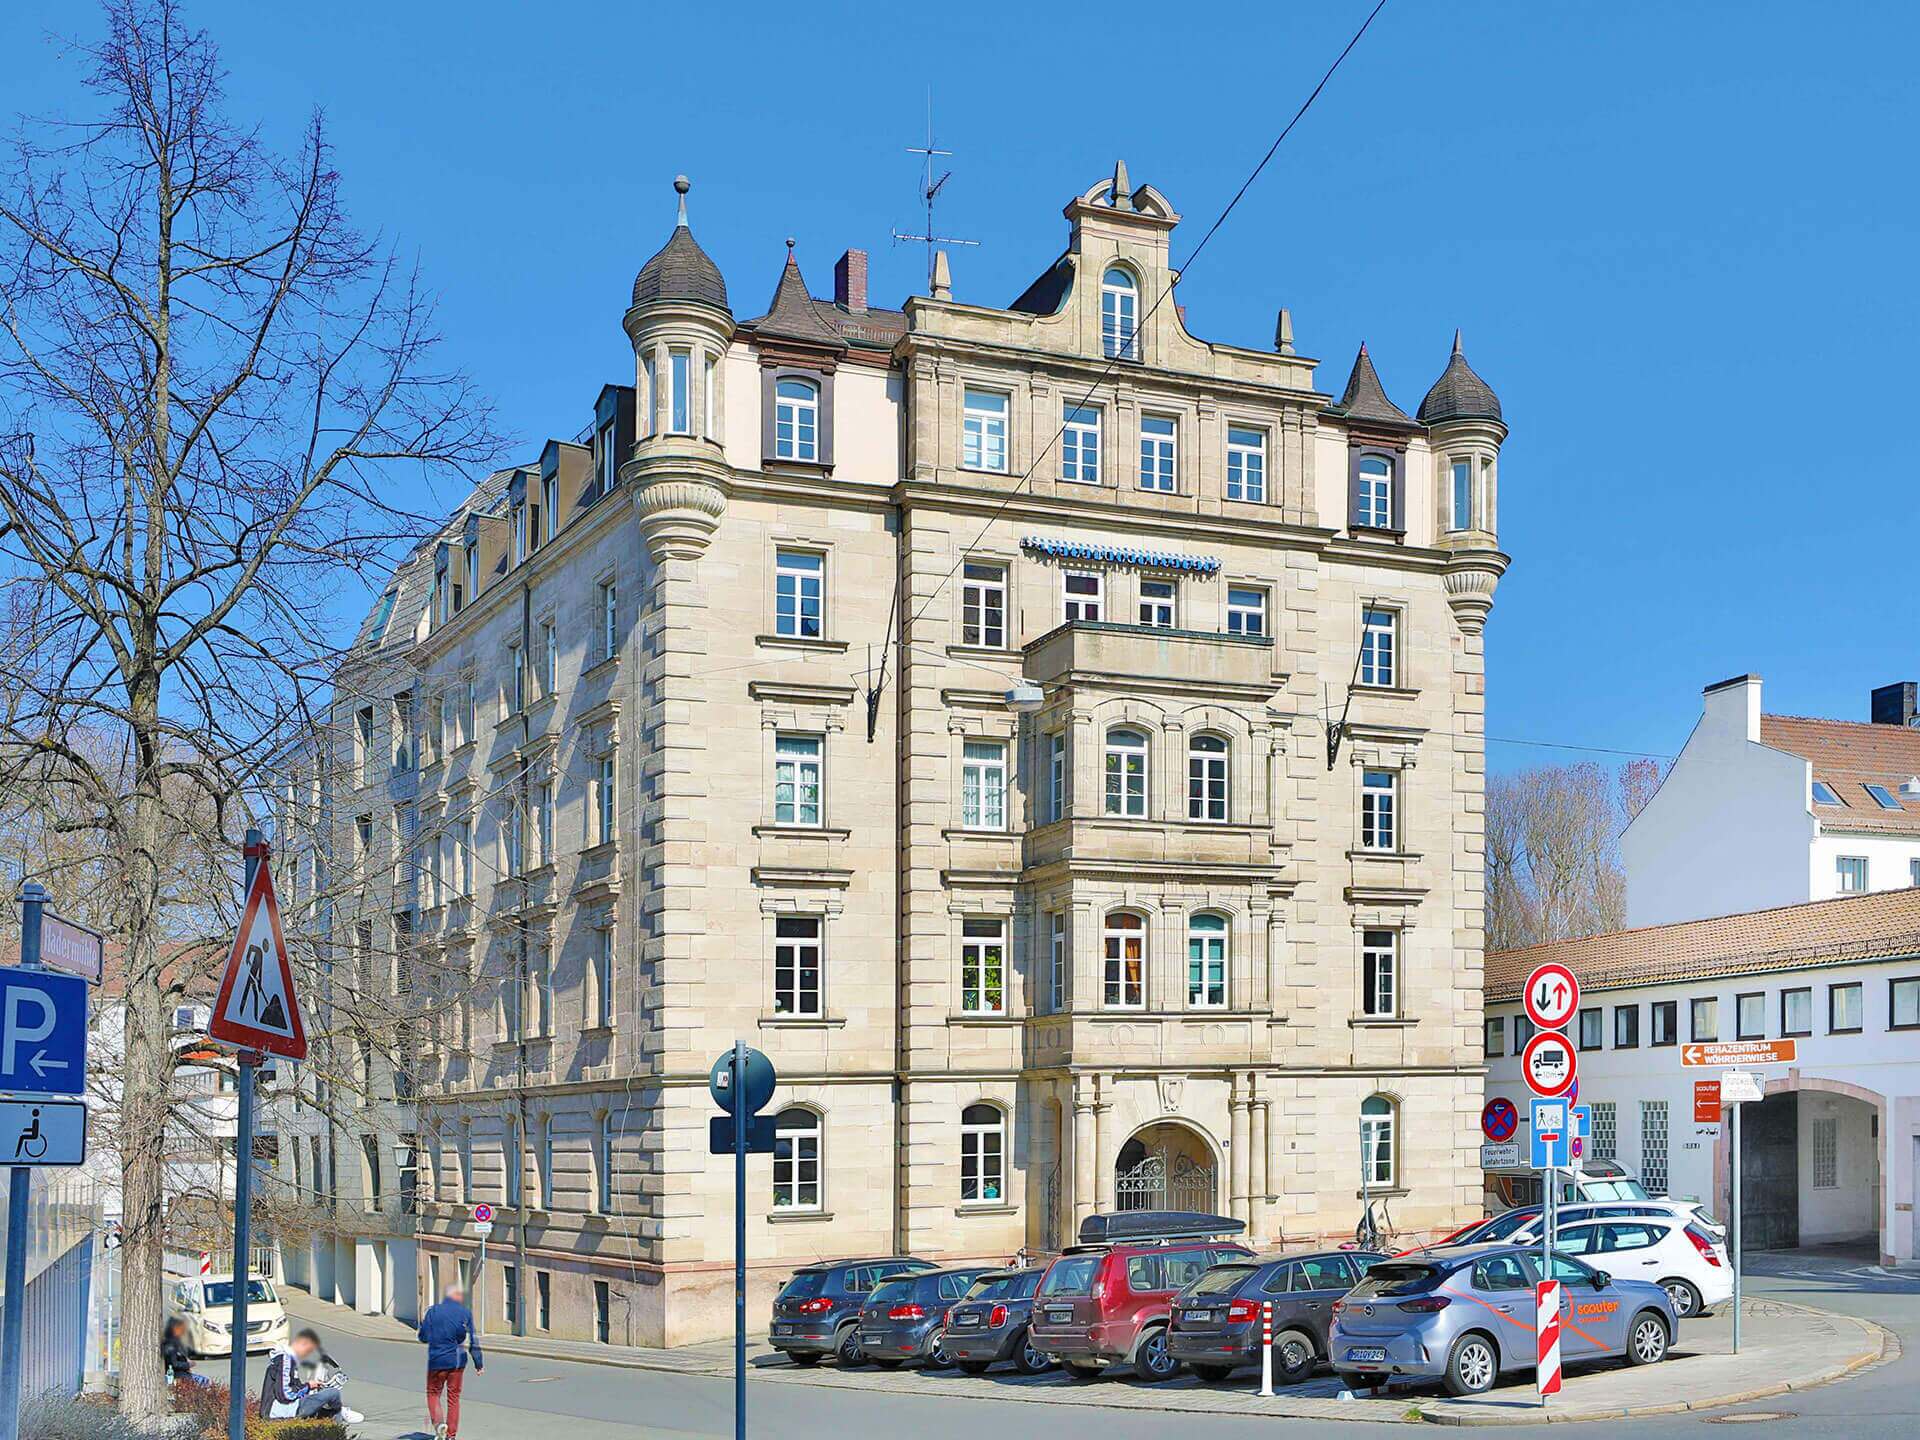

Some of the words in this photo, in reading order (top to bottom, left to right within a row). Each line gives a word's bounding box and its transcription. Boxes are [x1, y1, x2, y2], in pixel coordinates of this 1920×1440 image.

[44, 922, 97, 969] Hadermühle
[1, 985, 57, 1075] P
[1704, 1044, 1771, 1054] REHAZENTRUM
[1704, 1052, 1778, 1064] WÖHRDERWIESE
[1577, 1300, 1619, 1315] scouter
